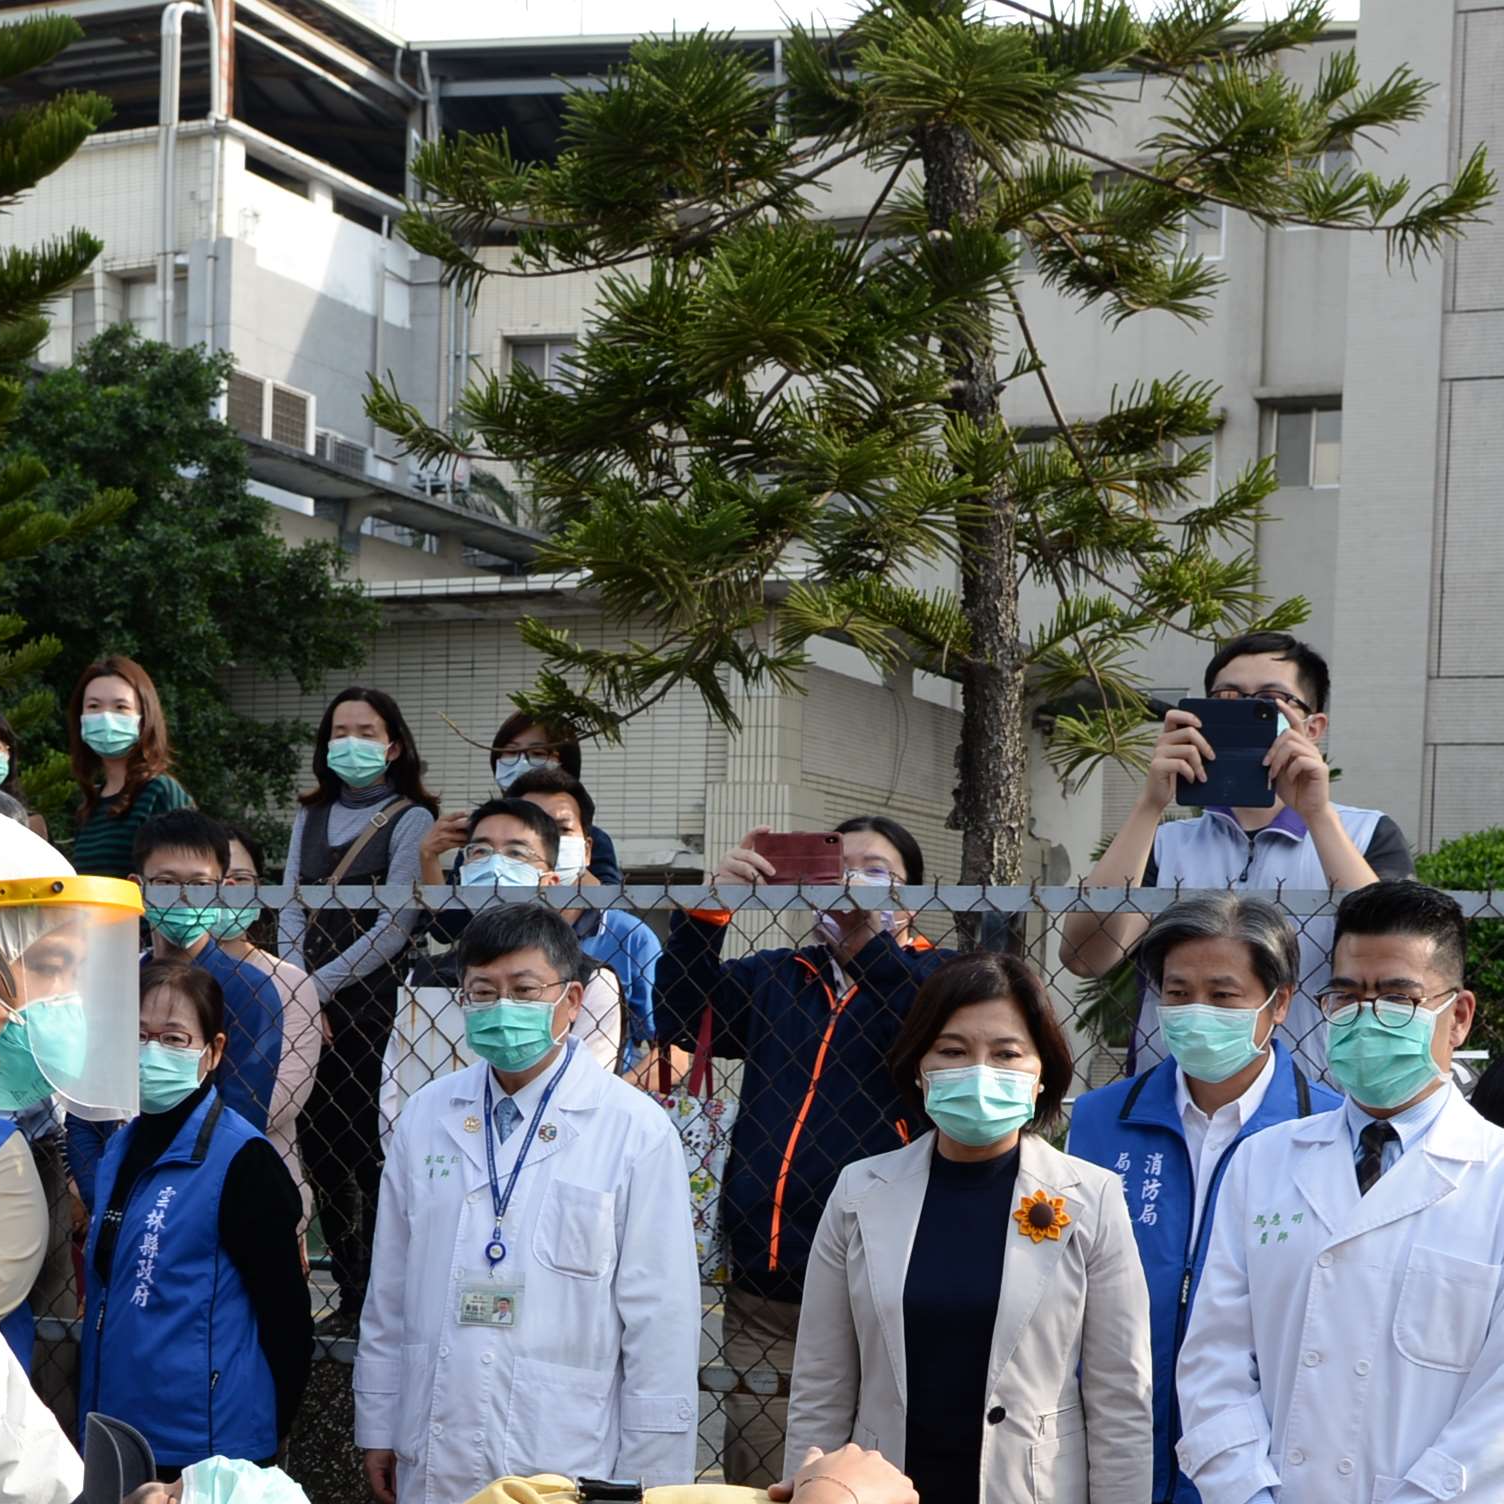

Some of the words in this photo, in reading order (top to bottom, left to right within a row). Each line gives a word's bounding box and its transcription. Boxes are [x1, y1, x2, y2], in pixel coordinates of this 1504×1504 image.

[1138, 1152, 1165, 1226] 消防局
[130, 1186, 177, 1308] 雲林縣政府
